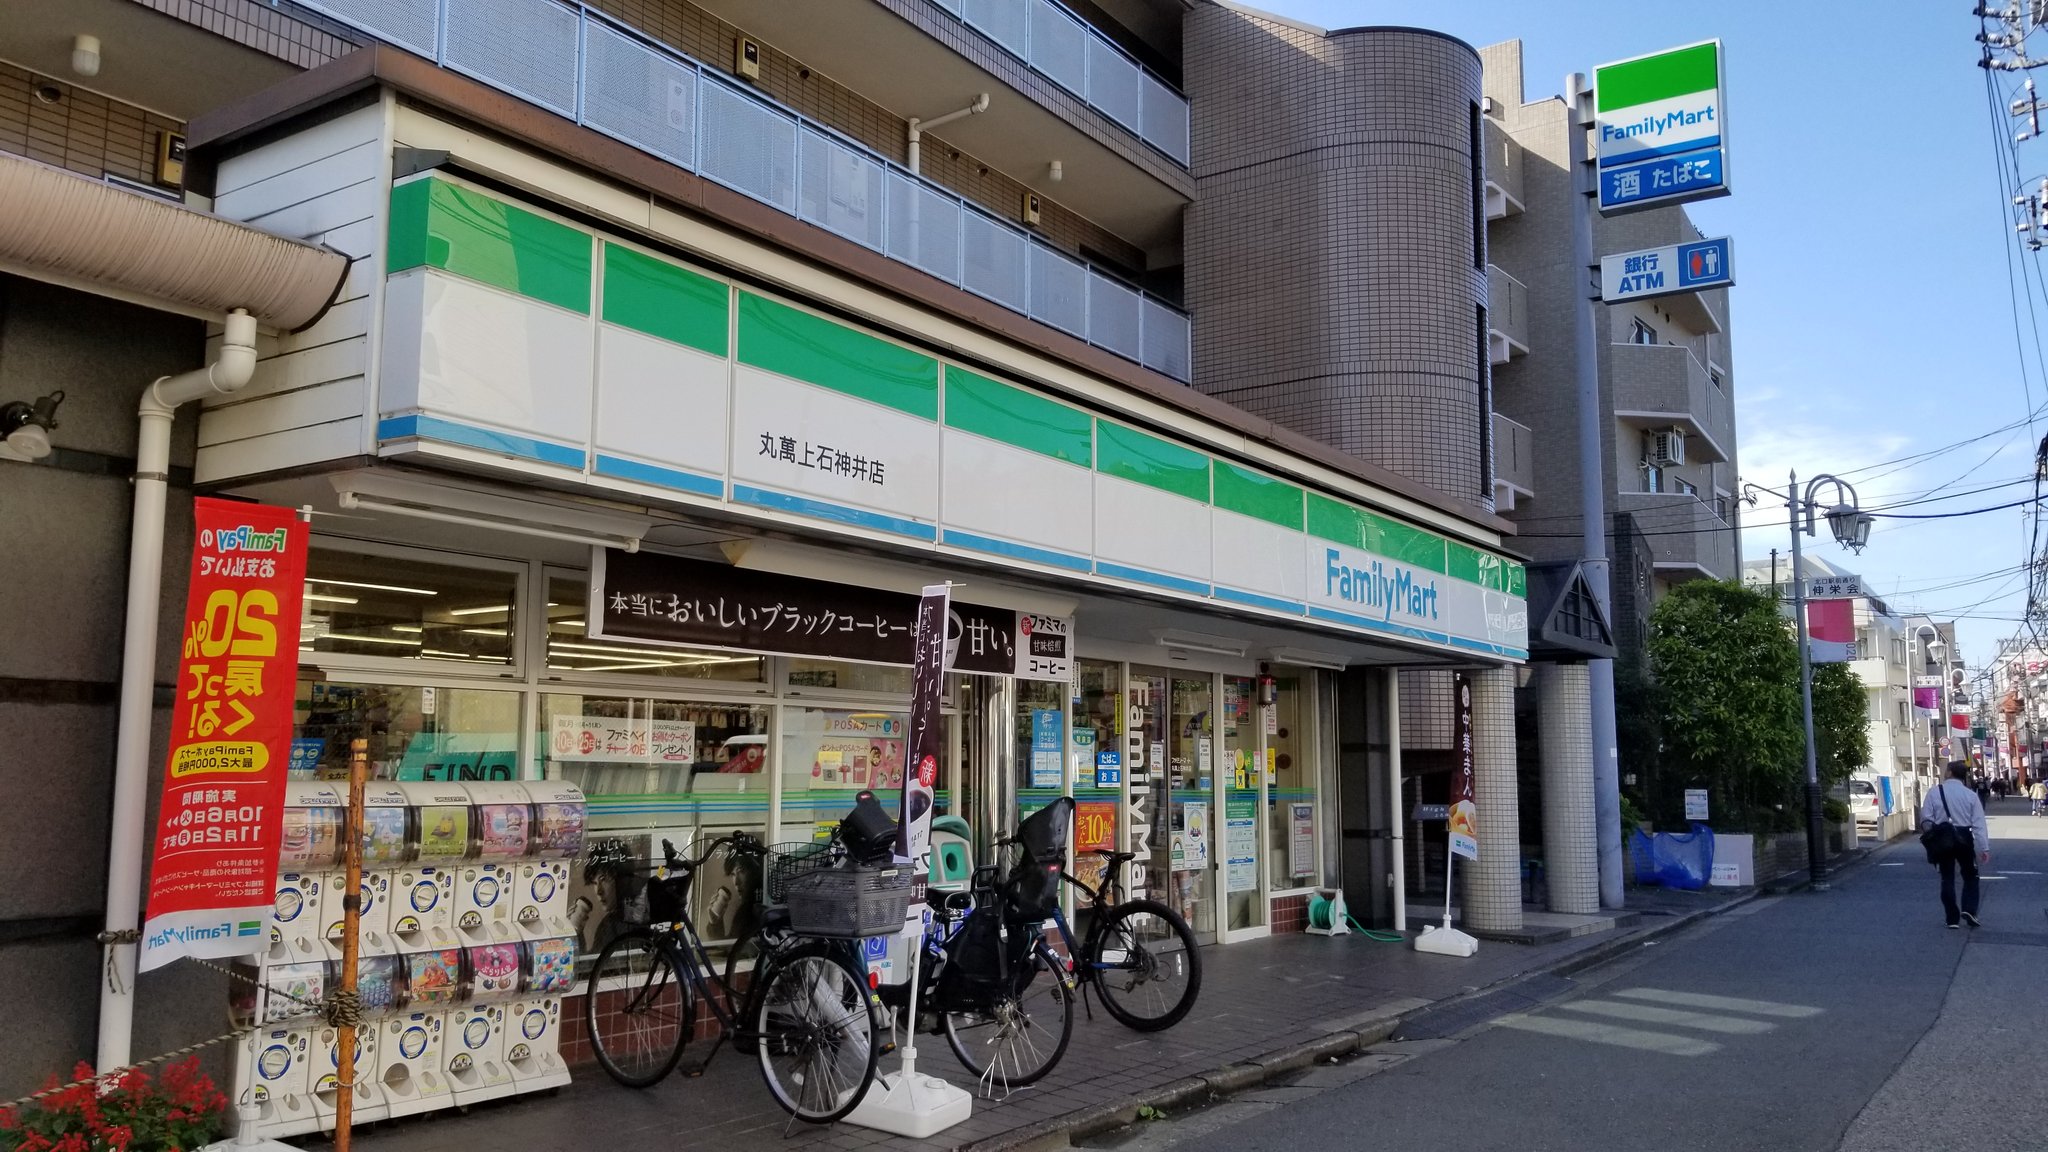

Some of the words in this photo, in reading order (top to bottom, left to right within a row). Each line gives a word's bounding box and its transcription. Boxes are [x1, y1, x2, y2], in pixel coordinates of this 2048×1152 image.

[1602, 105, 1714, 143] FamilyMart
[1613, 170, 1641, 199] 酒
[1652, 159, 1712, 189] たばこ
[1624, 253, 1659, 275] 銀行
[1618, 271, 1664, 294] ATM
[758, 431, 885, 486] 丸萬上石神井店
[1326, 547, 1438, 623] FamilyMart
[1813, 584, 1858, 595] 伸栄会
[1030, 614, 1066, 633] ファミマの
[966, 618, 1013, 657] 甘い。
[1033, 640, 1062, 652] 甘味焙煎
[1029, 659, 1066, 675] コーヒー
[1101, 754, 1117, 764] たばこ
